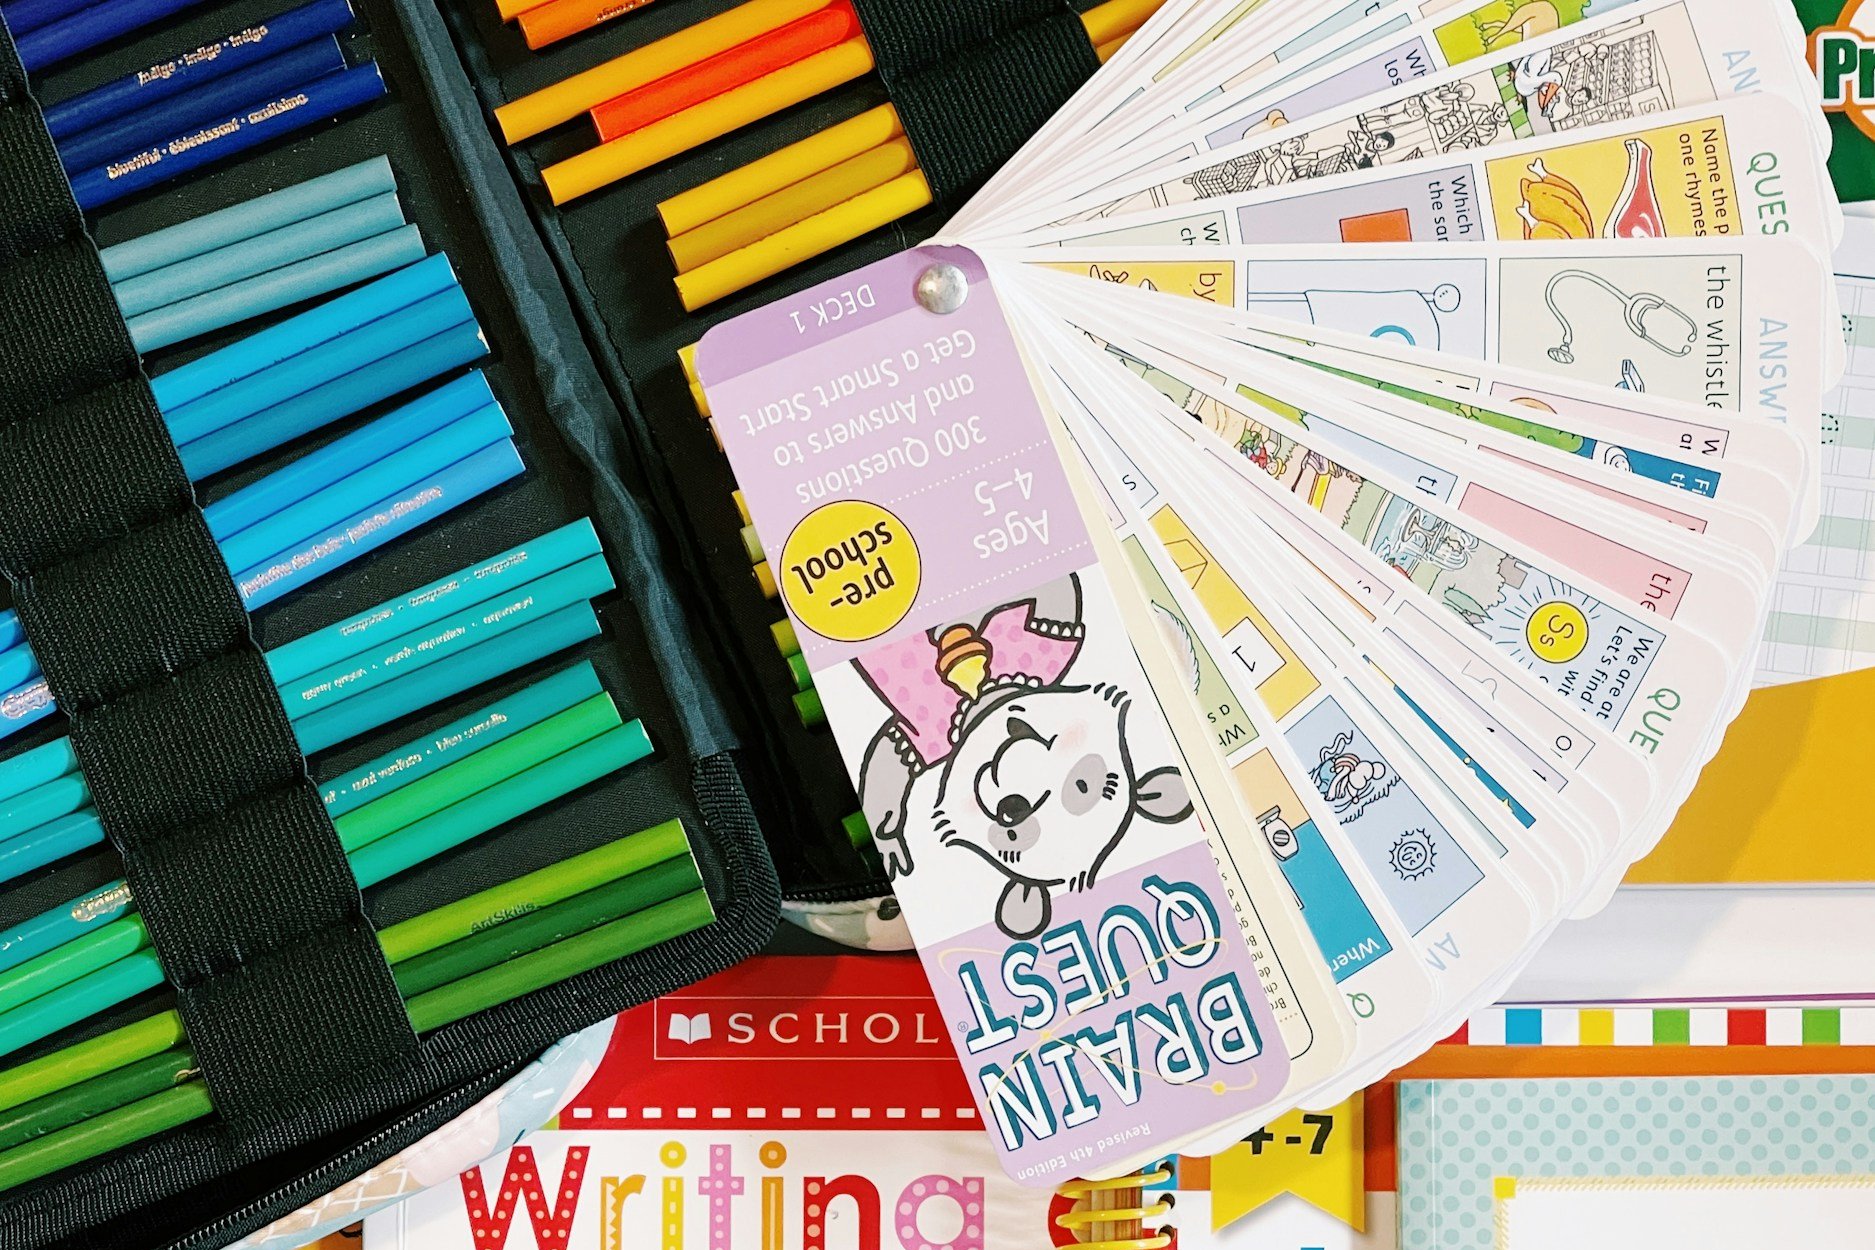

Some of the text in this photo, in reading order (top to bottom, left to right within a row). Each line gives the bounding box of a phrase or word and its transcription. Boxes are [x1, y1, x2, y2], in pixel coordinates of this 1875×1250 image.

[1427, 180, 1445, 211] the
[1451, 174, 1472, 235] Which
[1679, 132, 1708, 238] one rhymes
[1702, 128, 1720, 181] Name
[1711, 182, 1728, 222] the
[788, 283, 876, 334] DECK 1
[1193, 271, 1223, 303] by
[1706, 265, 1729, 310] the
[737, 329, 977, 437] Get a Smart Start
[773, 372, 976, 467] and Answers to
[794, 415, 988, 505] 300 Questions
[790, 520, 895, 595] school
[973, 509, 1050, 559] Ages
[830, 556, 895, 609] pre-
[1579, 624, 1633, 704] Let's find
[1596, 636, 1655, 721] We are at
[958, 874, 1222, 1055] QUEST
[979, 972, 1263, 1152] BRAIN
[1016, 1122, 1152, 1181] Revised 4th Edition
